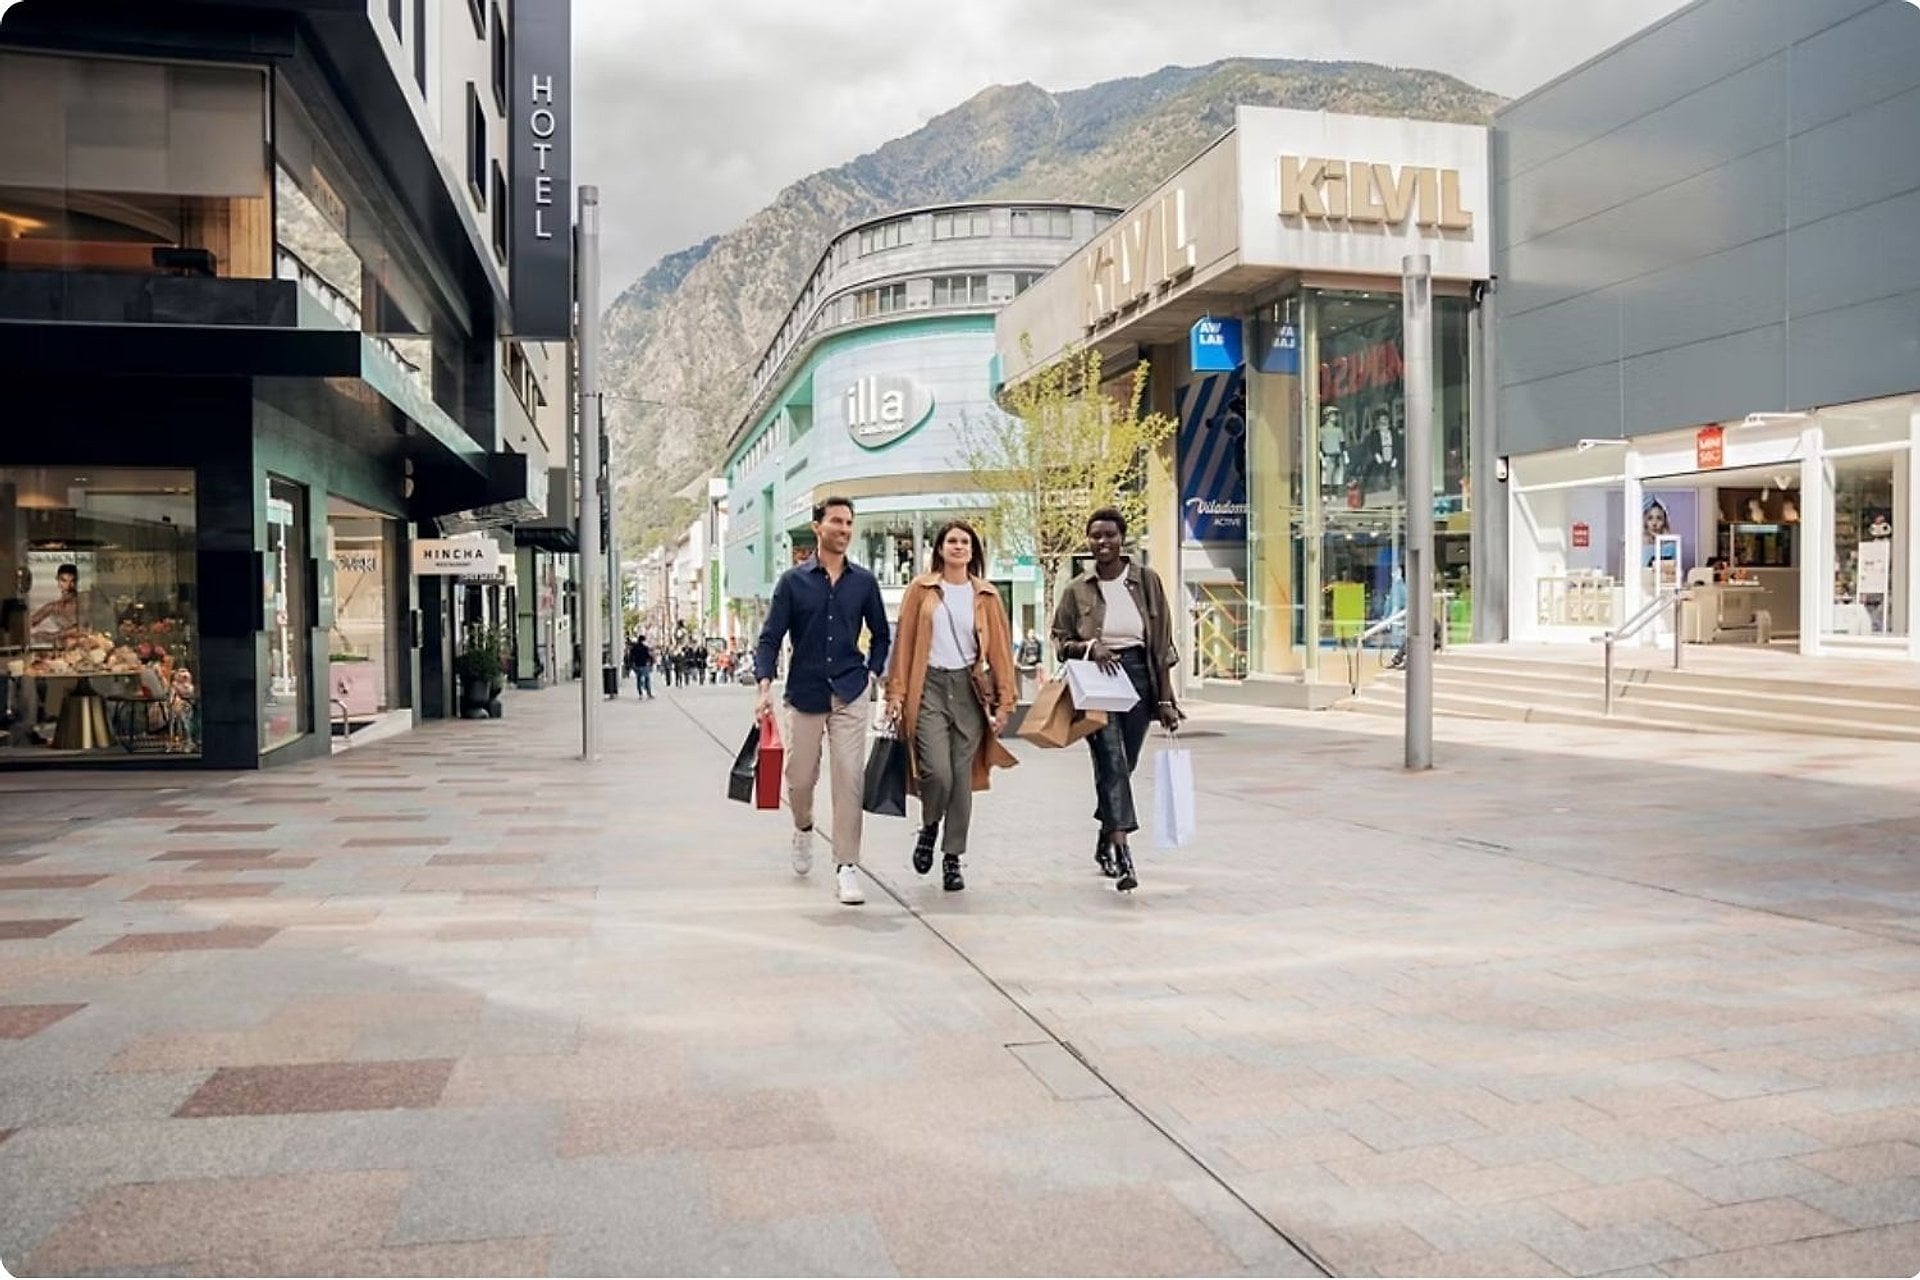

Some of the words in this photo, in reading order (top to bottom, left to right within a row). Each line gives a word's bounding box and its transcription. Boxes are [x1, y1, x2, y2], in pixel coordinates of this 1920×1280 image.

[530, 74, 556, 240] HOTEL
[1199, 322, 1222, 334] AW
[1198, 334, 1225, 346] LAB
[847, 374, 905, 428] illa
[424, 549, 484, 560] HINCHA
